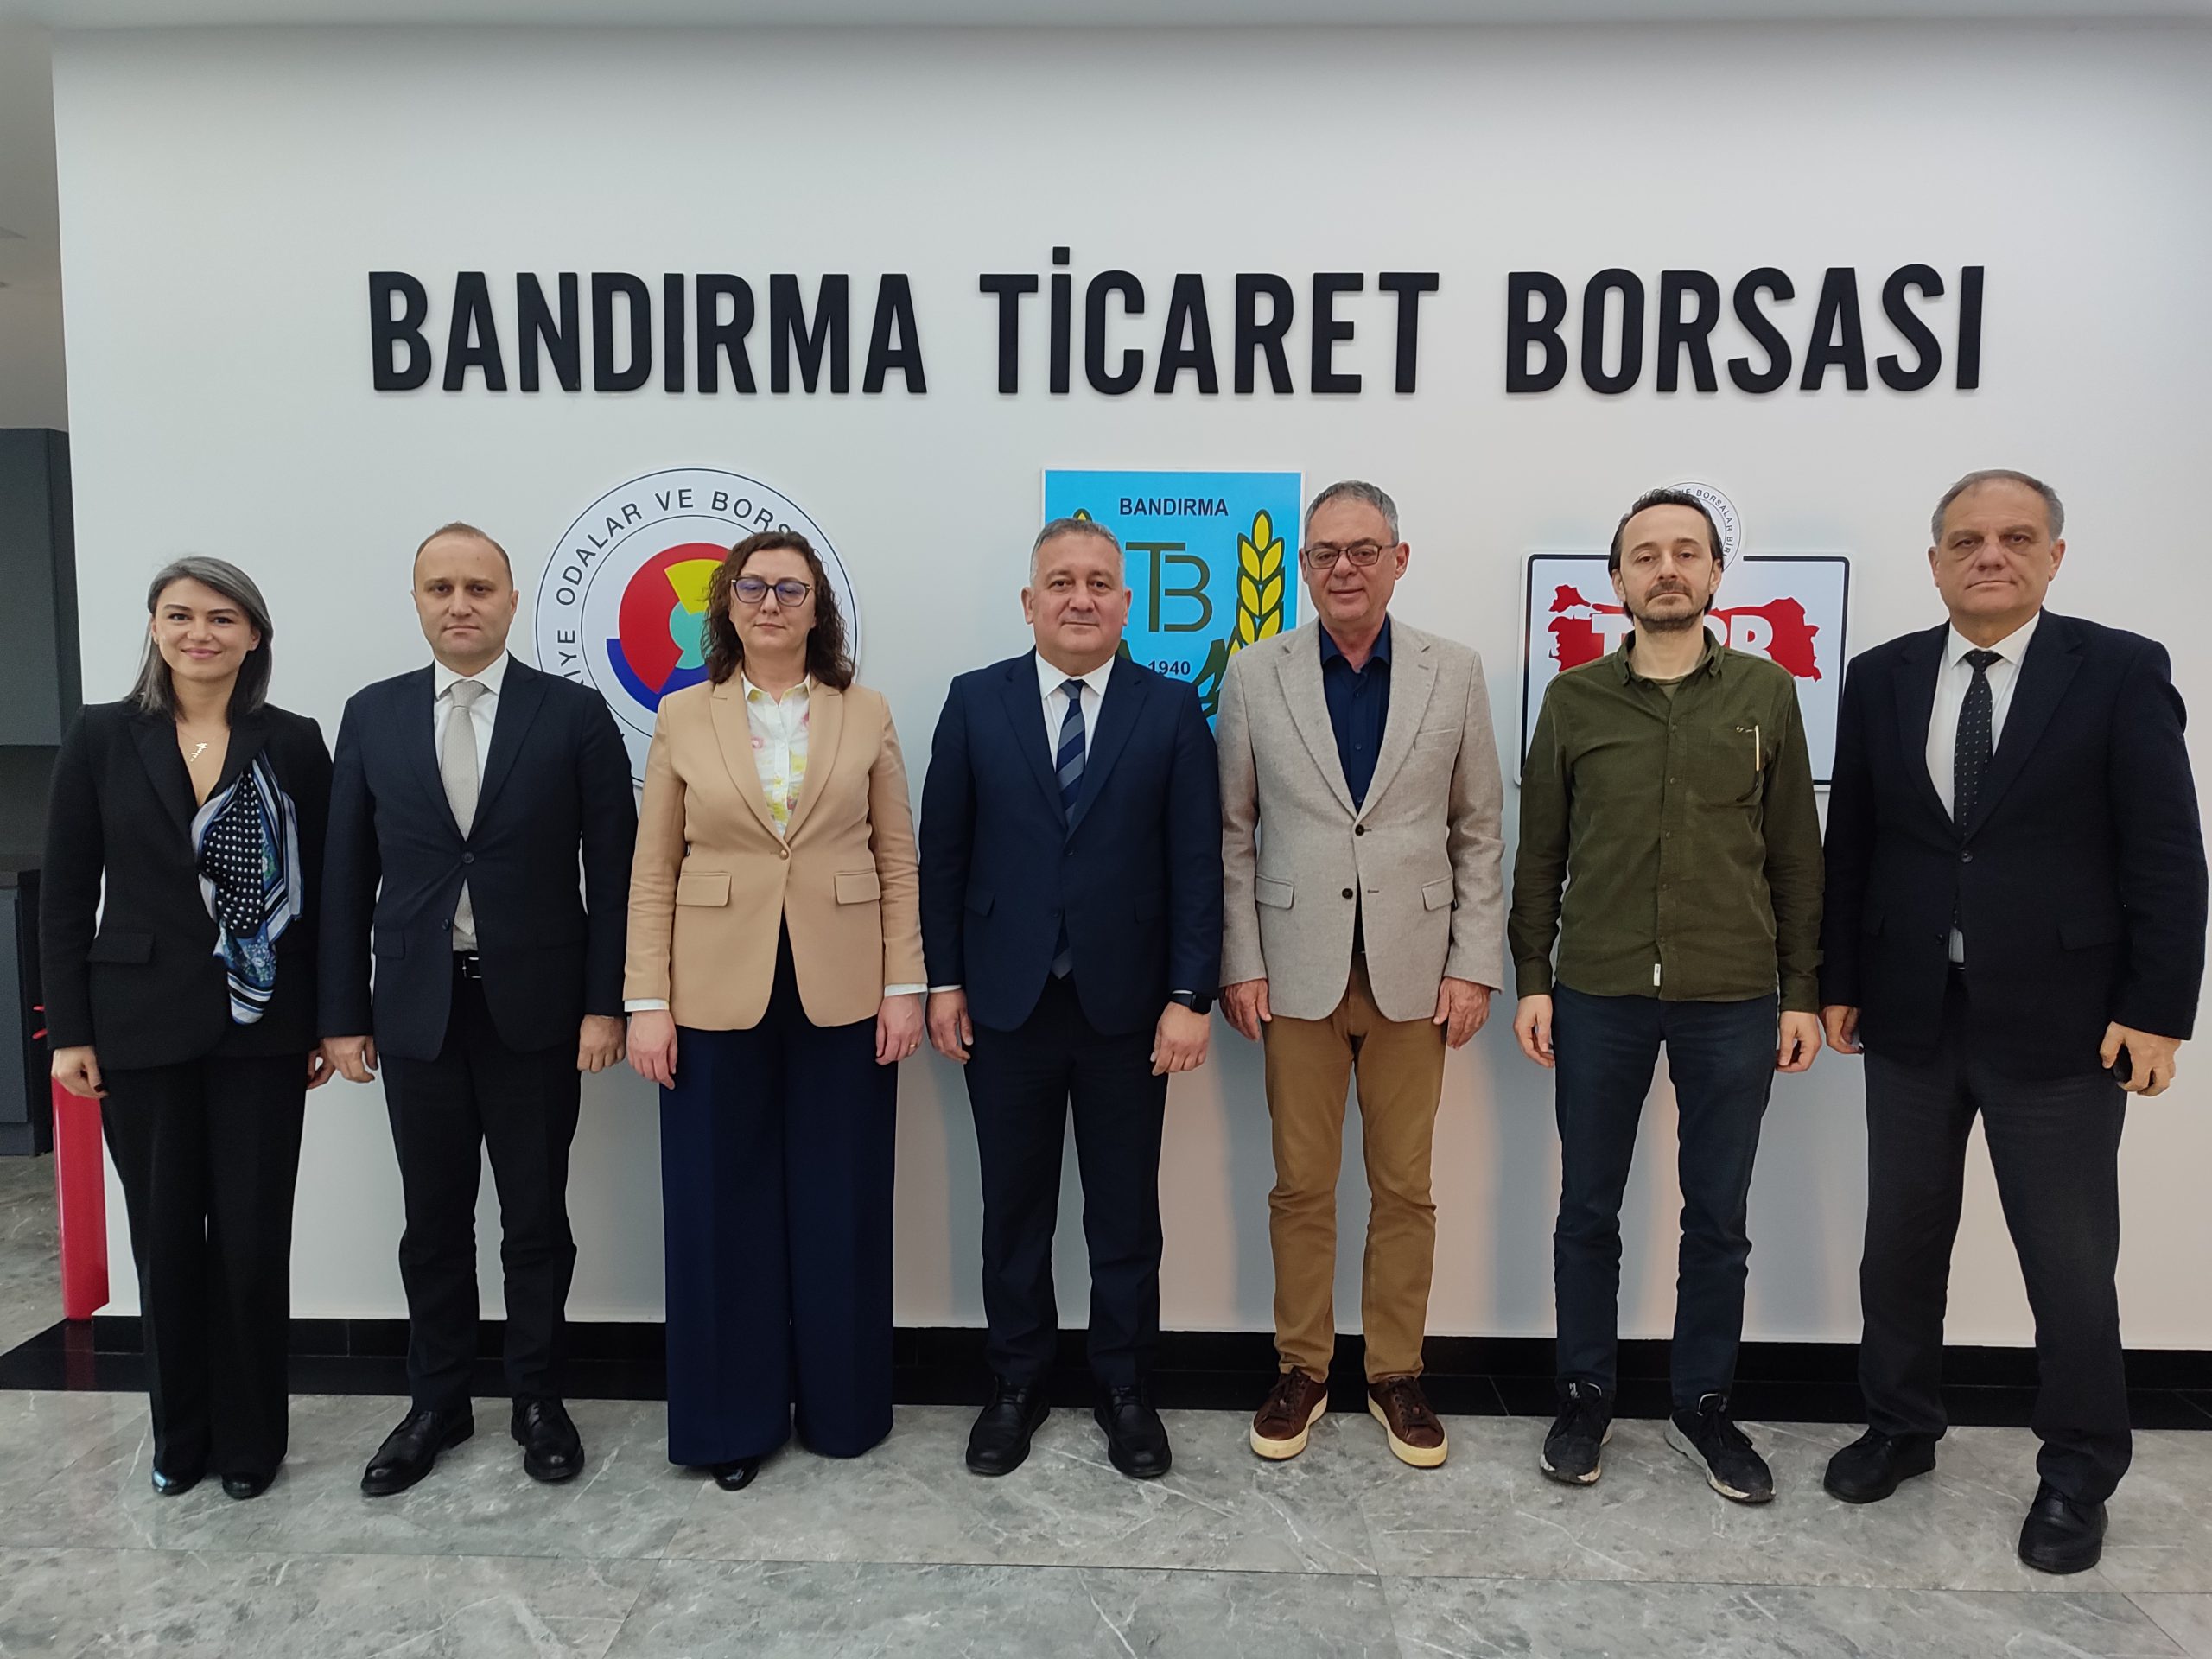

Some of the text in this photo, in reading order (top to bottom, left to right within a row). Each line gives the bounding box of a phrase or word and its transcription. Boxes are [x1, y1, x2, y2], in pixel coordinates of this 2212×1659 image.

[369, 246, 1985, 395] BANDIRMA TİCARET BORSASI
[1119, 498, 1229, 517] BANDIRMA
[1696, 489, 1733, 531] BORSALAR
[556, 503, 643, 606] ODALAR
[654, 488, 694, 512] VE
[1125, 541, 1213, 633] TB
[1148, 660, 1192, 675] 1940
